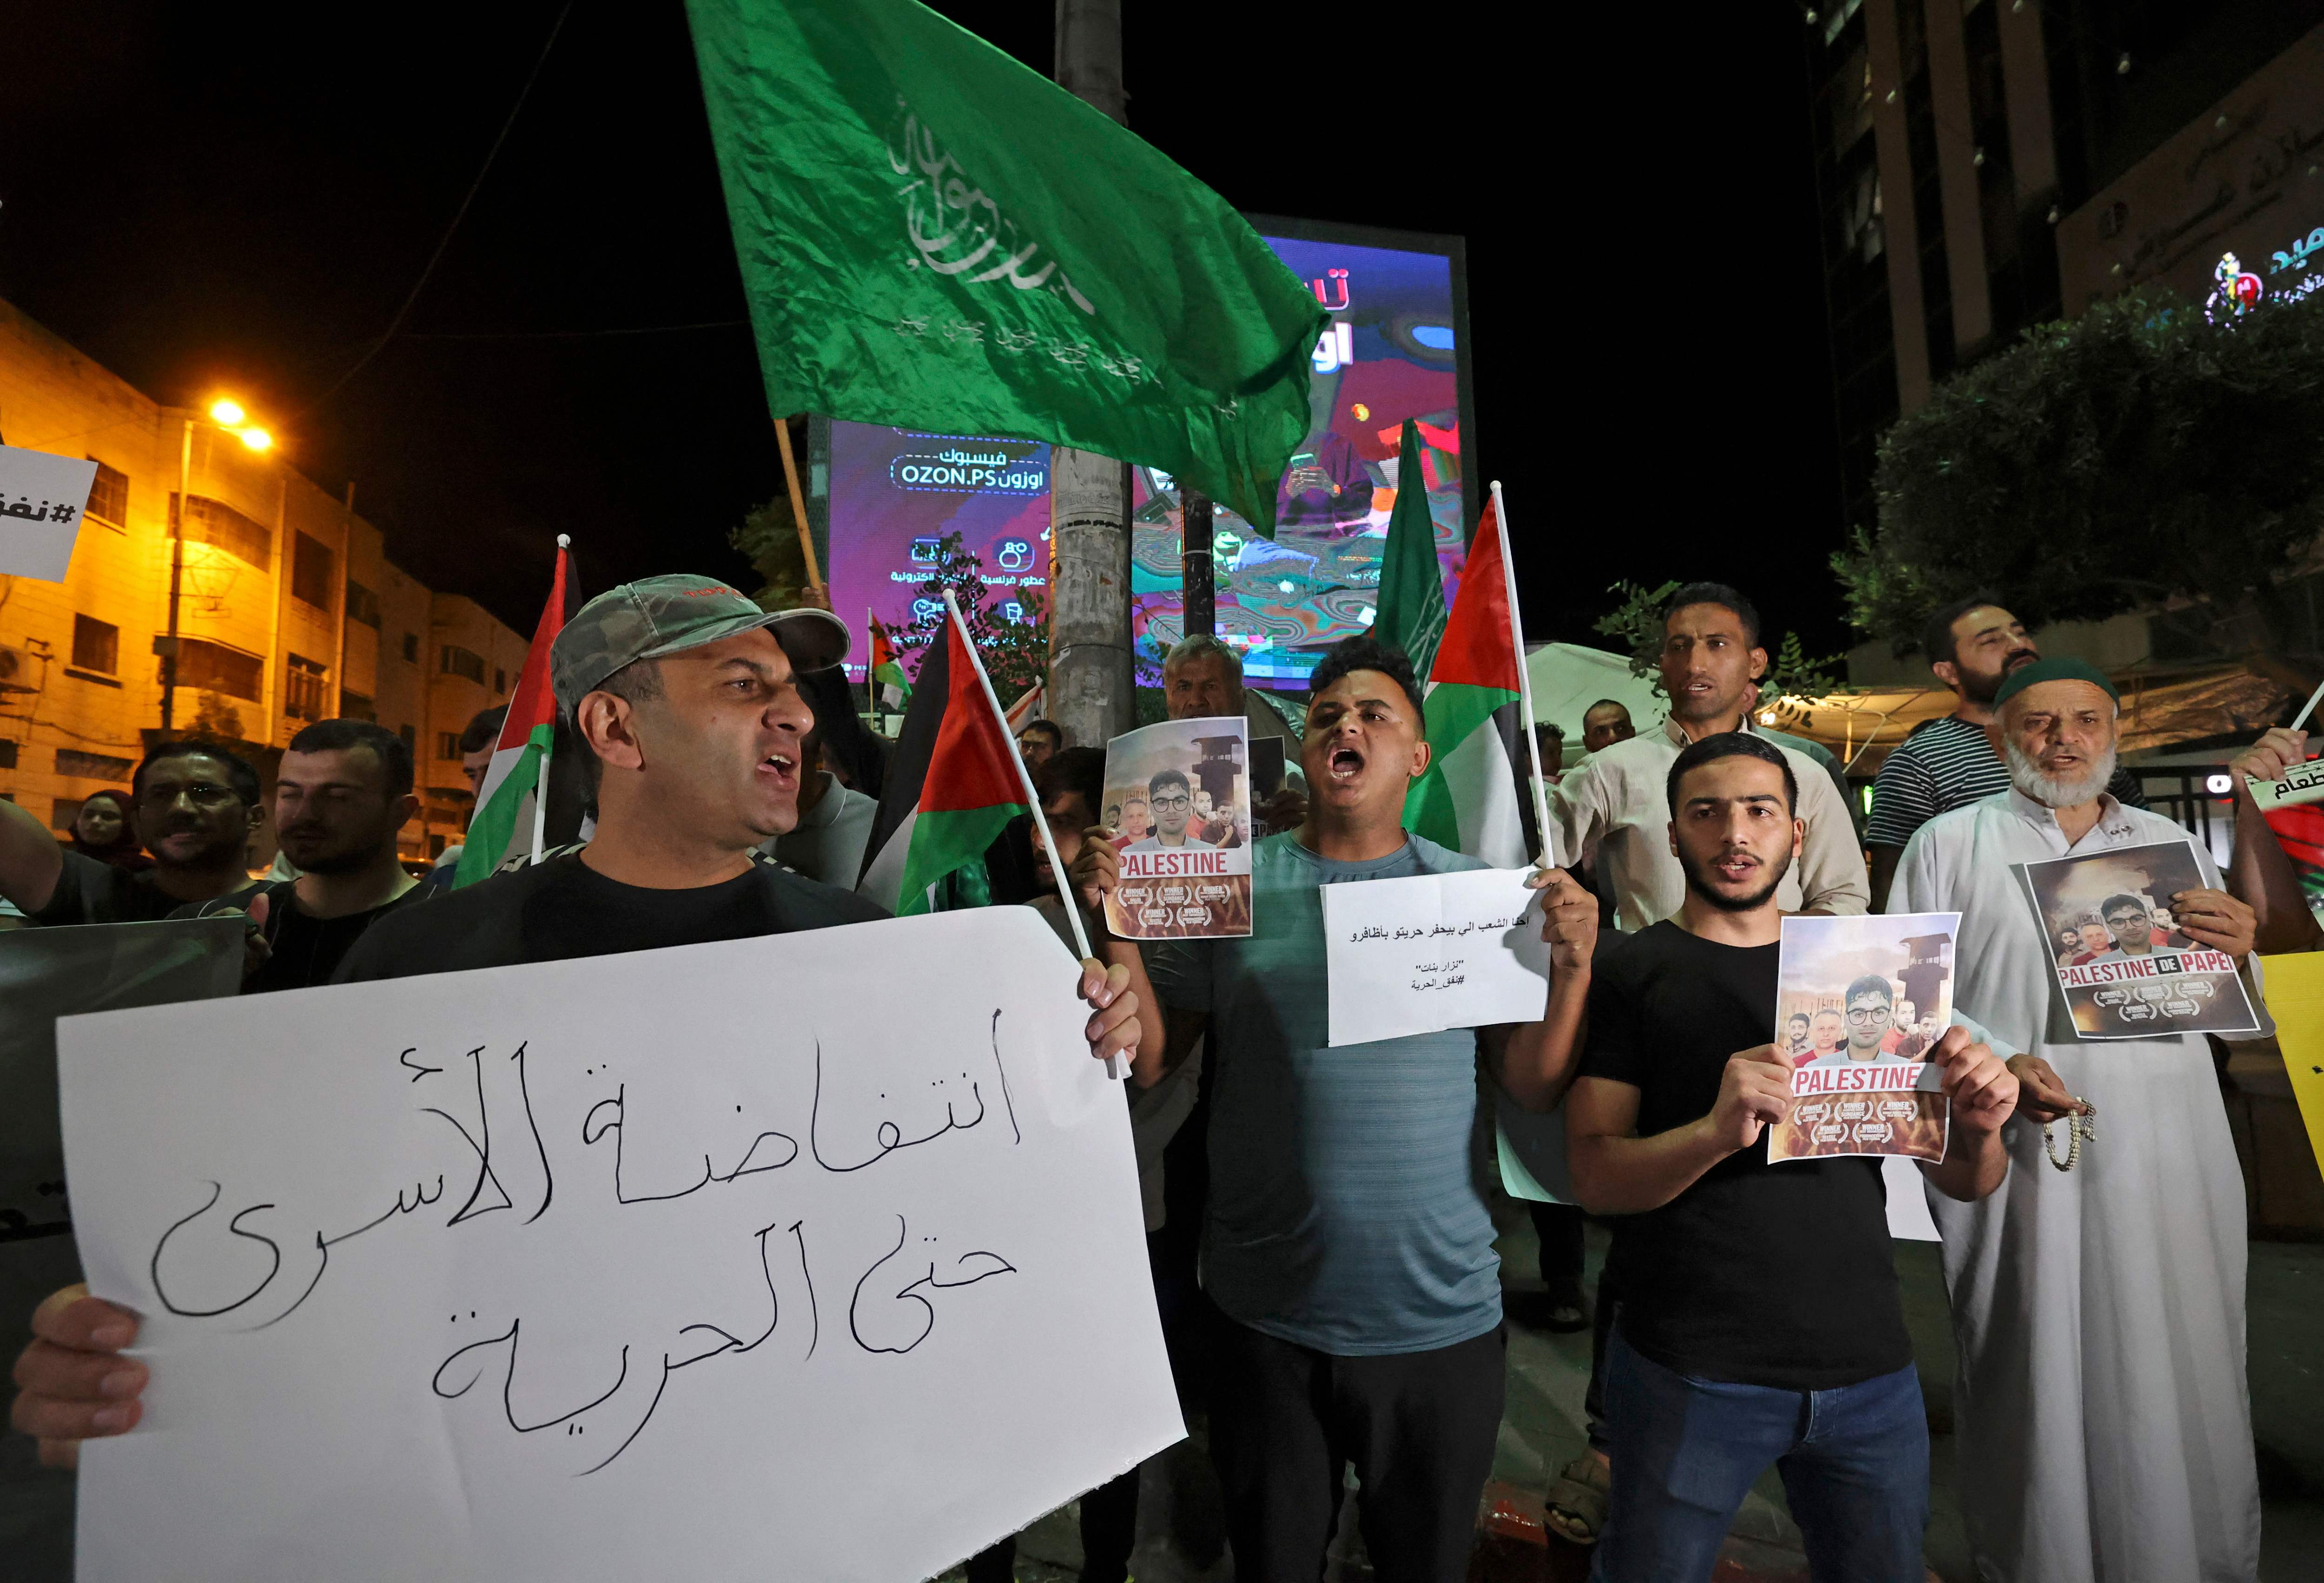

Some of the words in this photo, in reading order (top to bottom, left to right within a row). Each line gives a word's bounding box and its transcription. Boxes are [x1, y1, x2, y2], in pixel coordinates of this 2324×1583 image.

[939, 448, 1007, 468] فيسبوك
[901, 465, 996, 487] OZON.PS
[998, 469, 1043, 489] اوزون
[980, 574, 1016, 586] فرنسية
[1018, 574, 1046, 587] عطور
[1428, 923, 1455, 937] بيحفر
[1478, 918, 1508, 932] الشعب
[1512, 916, 1529, 929] إحنا
[1349, 924, 1388, 943] بأظافرو
[1393, 927, 1423, 940] حريتو
[2160, 958, 2177, 972] DE
[1795, 1066, 1921, 1094] PALESTINE
[583, 1009, 1021, 1204] انتفاضة
[1802, 1104, 1823, 1113] WINNER
[151, 1039, 552, 1330] الأسرى
[850, 1214, 1017, 1353] حتى
[432, 1220, 818, 1477] الحرية
